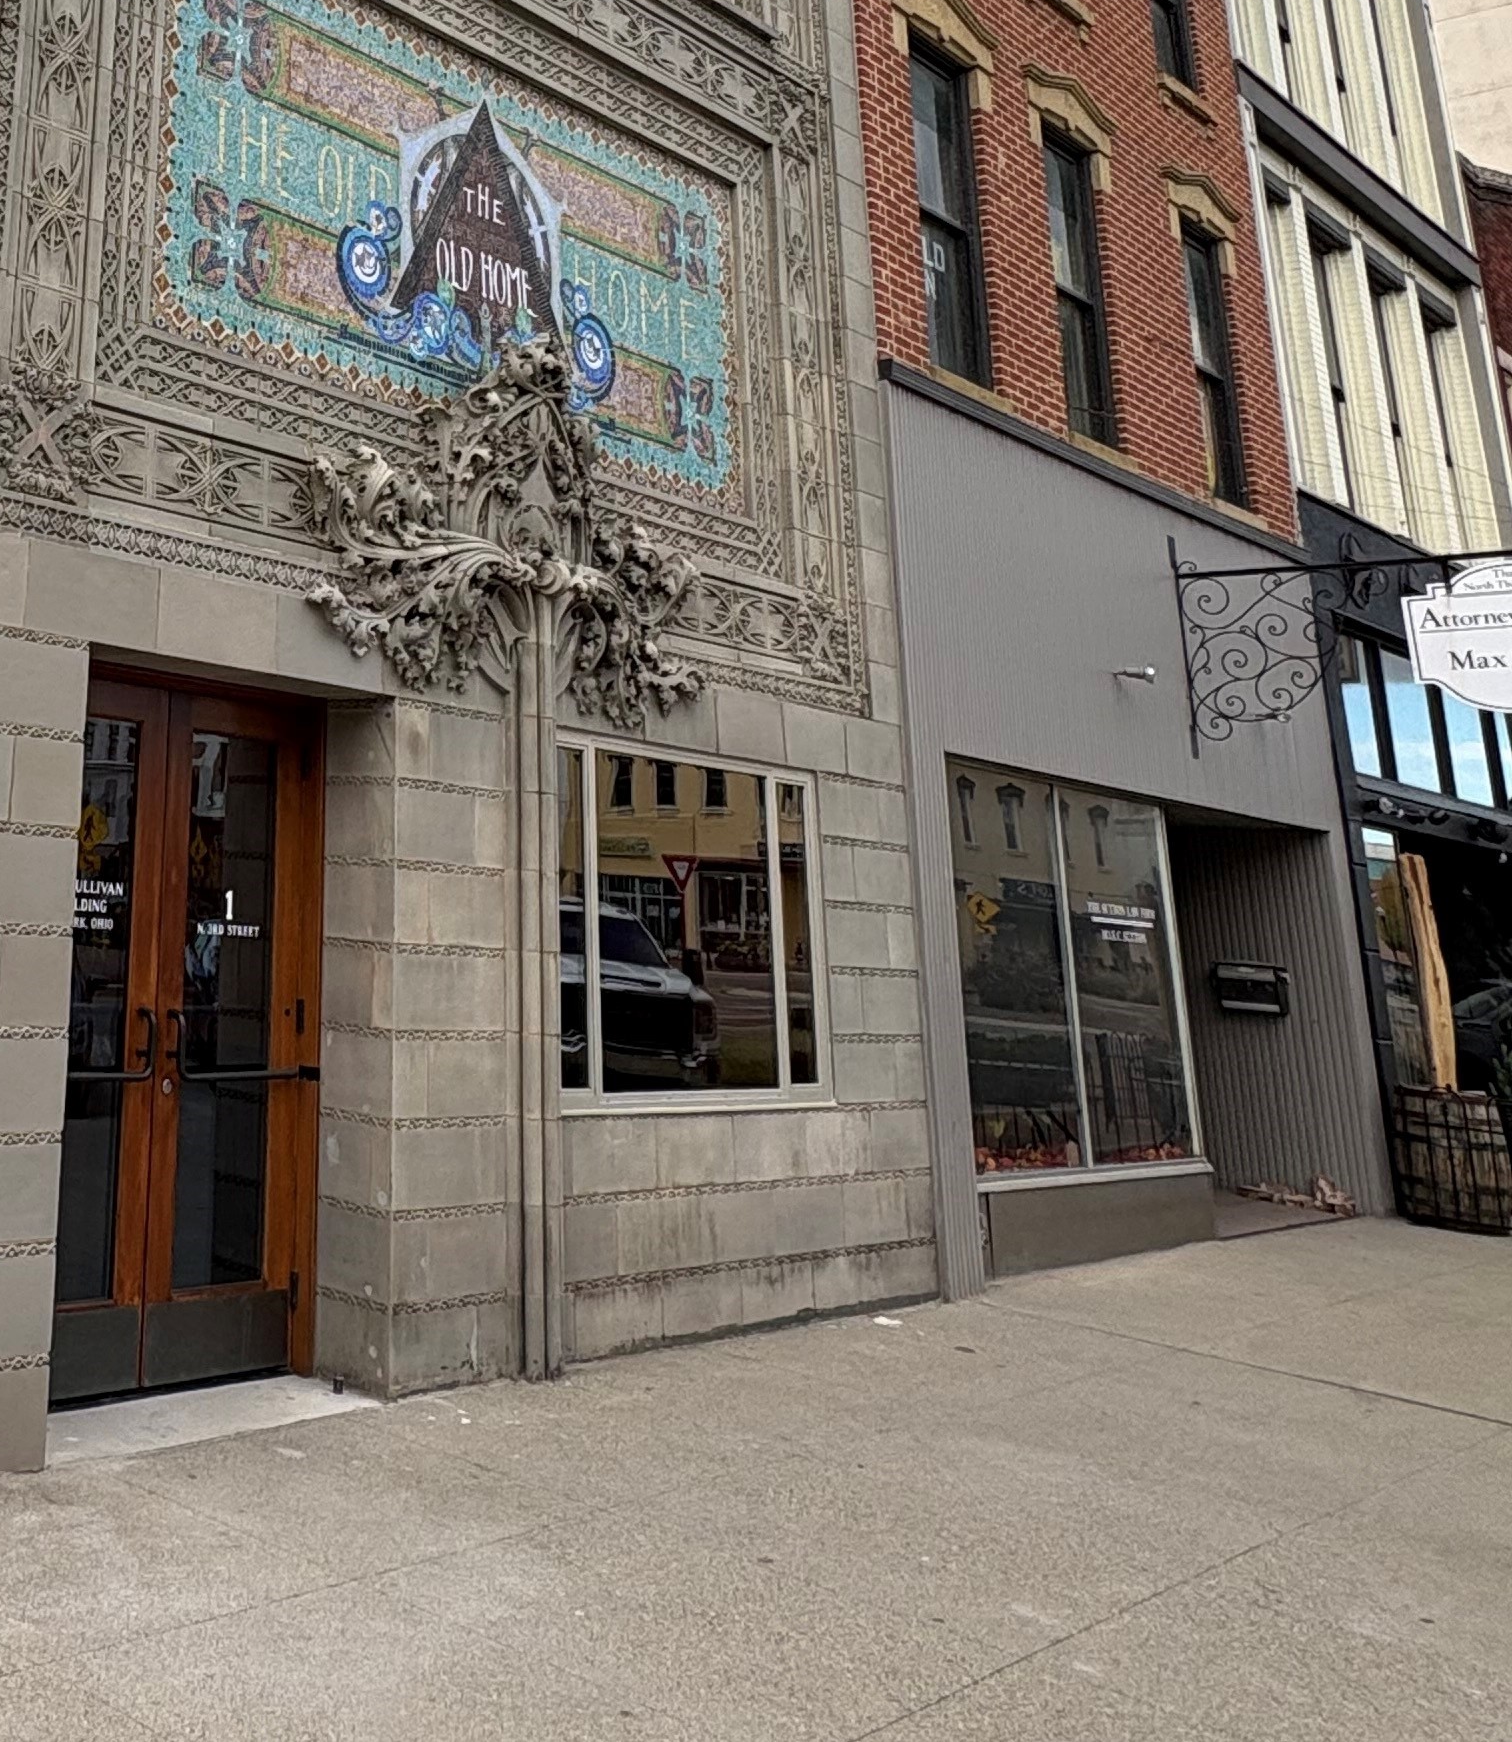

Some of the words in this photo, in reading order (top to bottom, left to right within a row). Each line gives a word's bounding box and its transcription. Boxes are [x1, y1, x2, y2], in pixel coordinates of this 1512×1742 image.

[462, 183, 506, 226] THE
[210, 95, 299, 202] THE
[574, 254, 699, 362] HOME
[921, 235, 946, 274] LD
[435, 237, 474, 292] OLD
[480, 251, 539, 318] HOME
[1448, 649, 1509, 671] Max
[75, 879, 124, 897] ULLIVAN
[74, 898, 108, 914] LDING
[225, 890, 234, 921] 1
[227, 924, 260, 938] STREET
